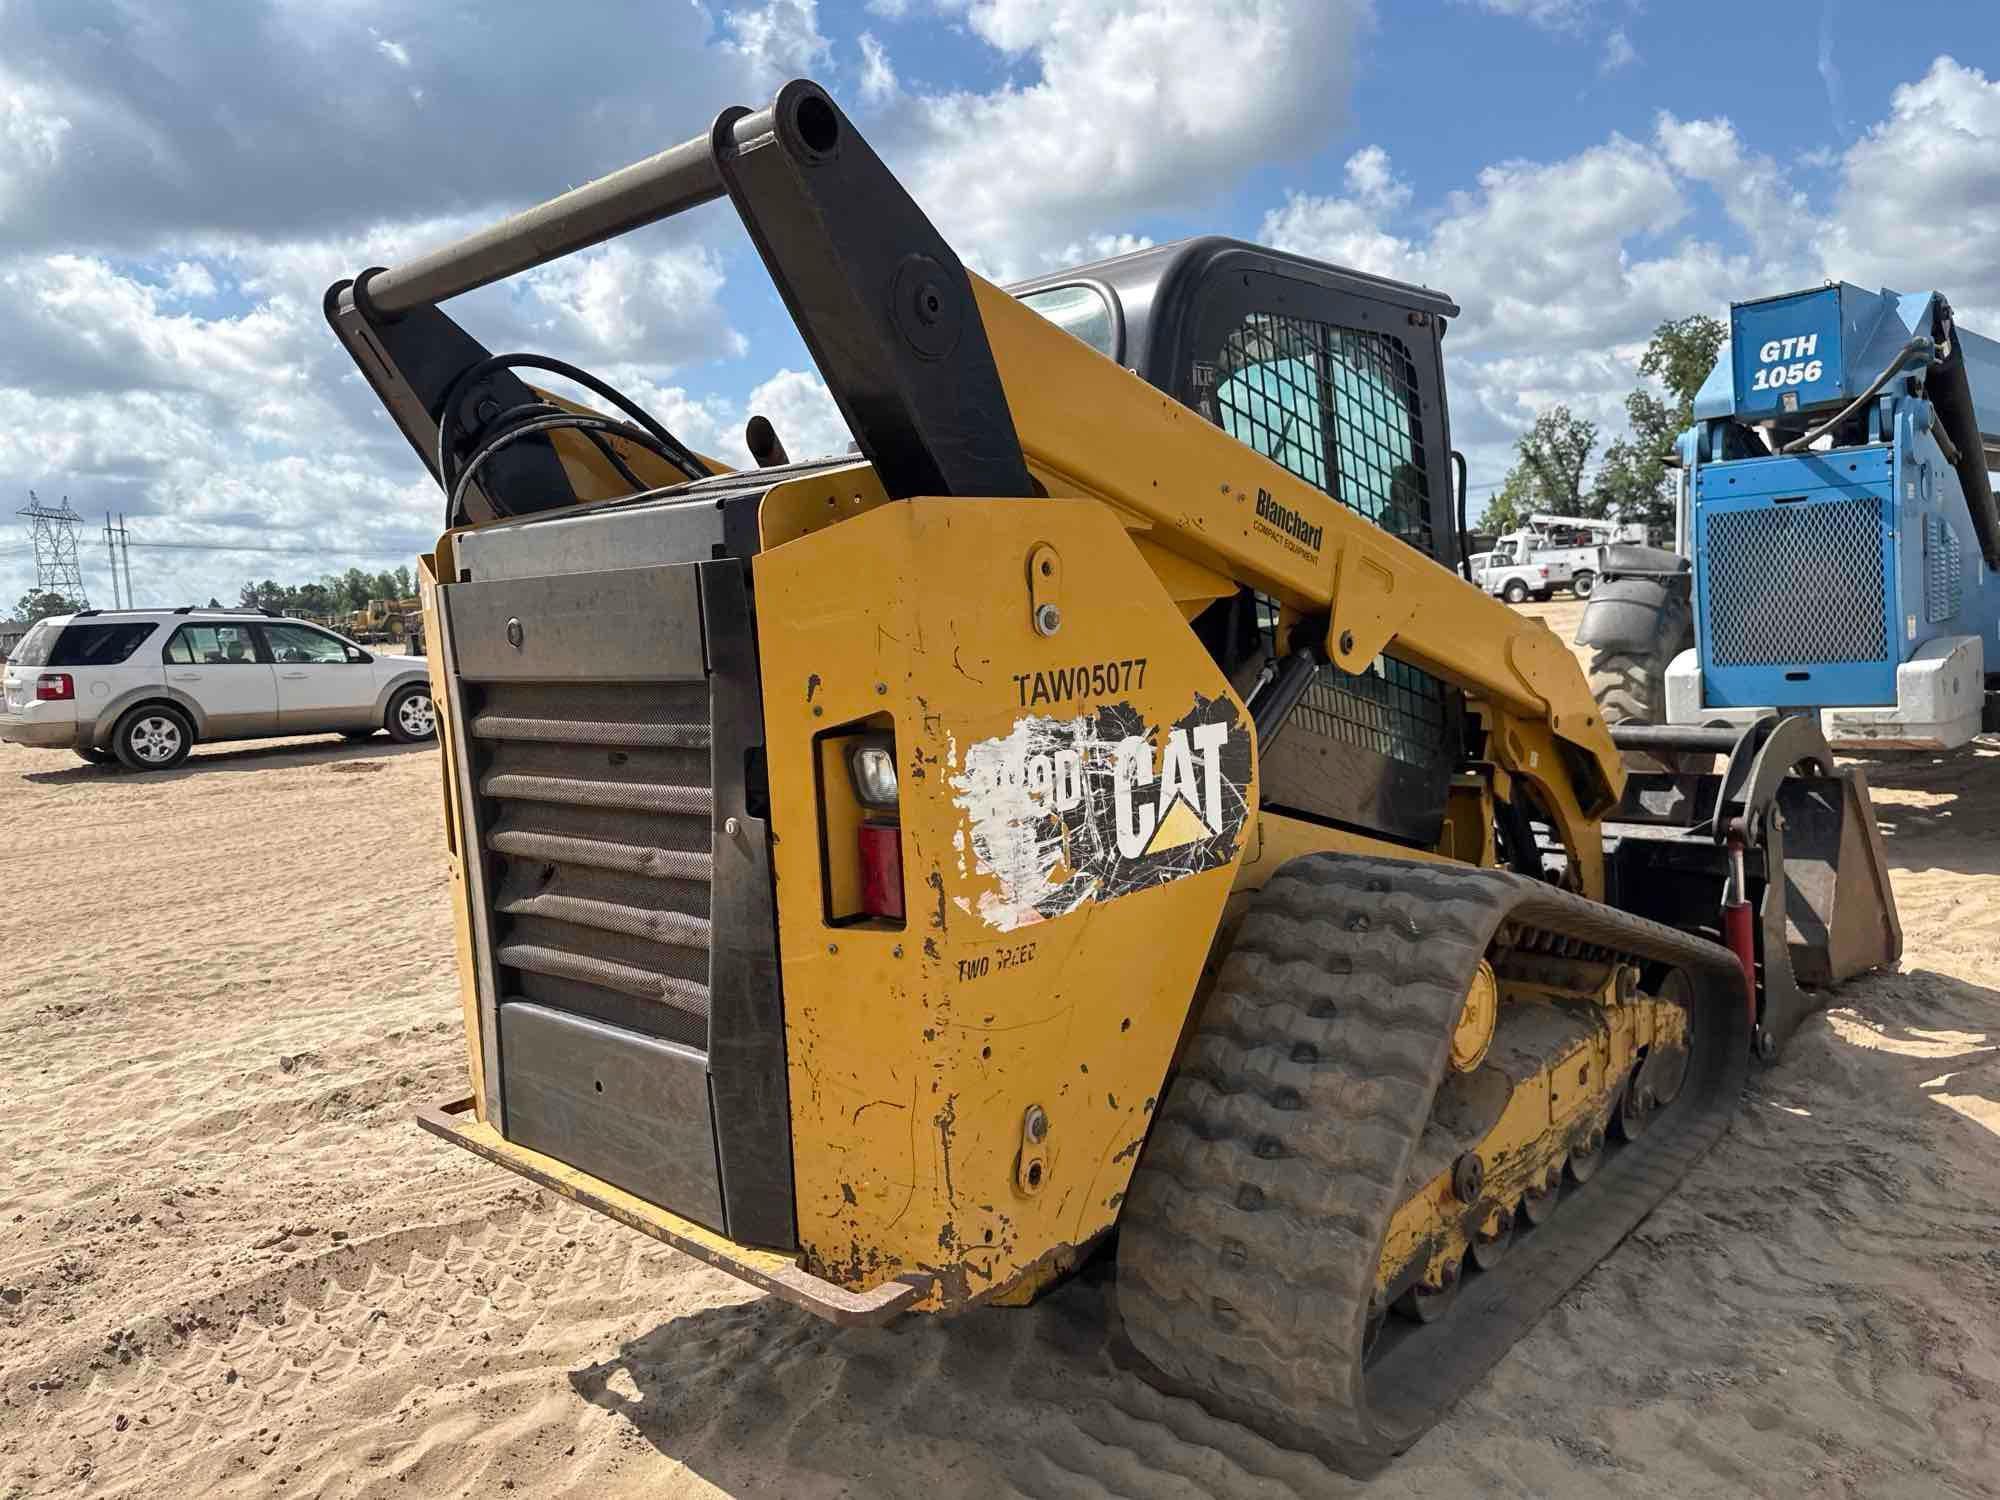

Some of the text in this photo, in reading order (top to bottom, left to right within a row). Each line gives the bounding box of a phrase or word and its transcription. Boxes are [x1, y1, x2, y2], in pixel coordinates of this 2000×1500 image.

[1760, 333, 1818, 363] GTH
[1752, 360, 1823, 391] 1056
[1253, 519, 1284, 545] COMPACT
[1256, 487, 1323, 552] Blanchard
[1012, 658, 1147, 706] TAW05077
[1114, 722, 1228, 860] CAT
[958, 956, 990, 982] TWO
